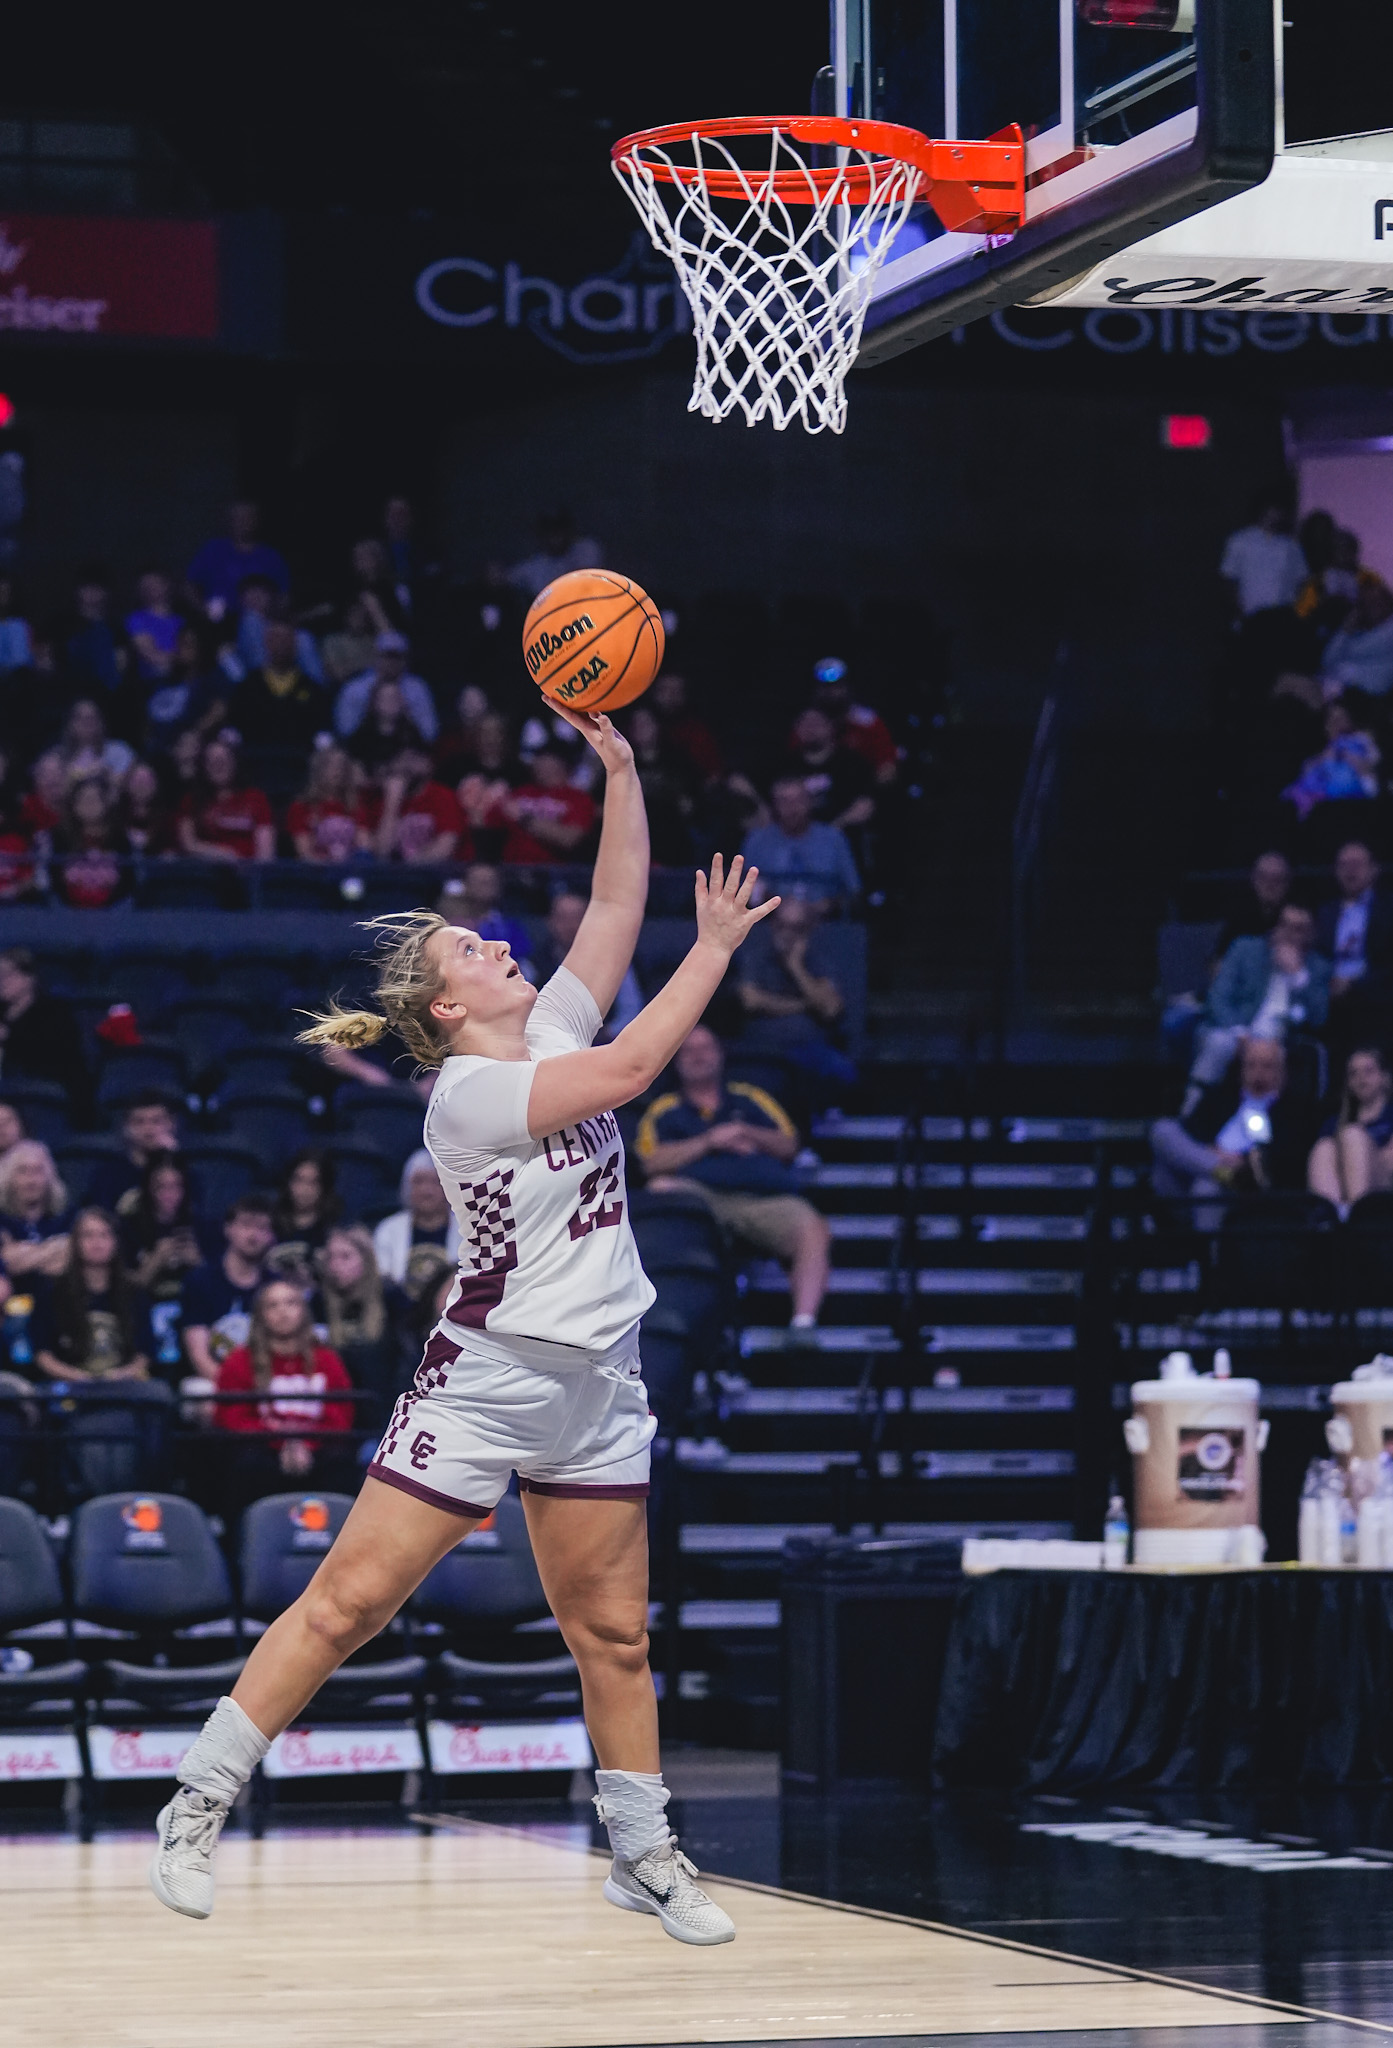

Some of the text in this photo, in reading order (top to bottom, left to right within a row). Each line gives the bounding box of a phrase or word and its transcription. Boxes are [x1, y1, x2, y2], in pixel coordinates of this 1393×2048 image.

[989, 306, 1393, 357] Coliseu
[525, 613, 597, 676] Wilson
[554, 655, 609, 702] NCAA
[567, 1150, 624, 1241] 22
